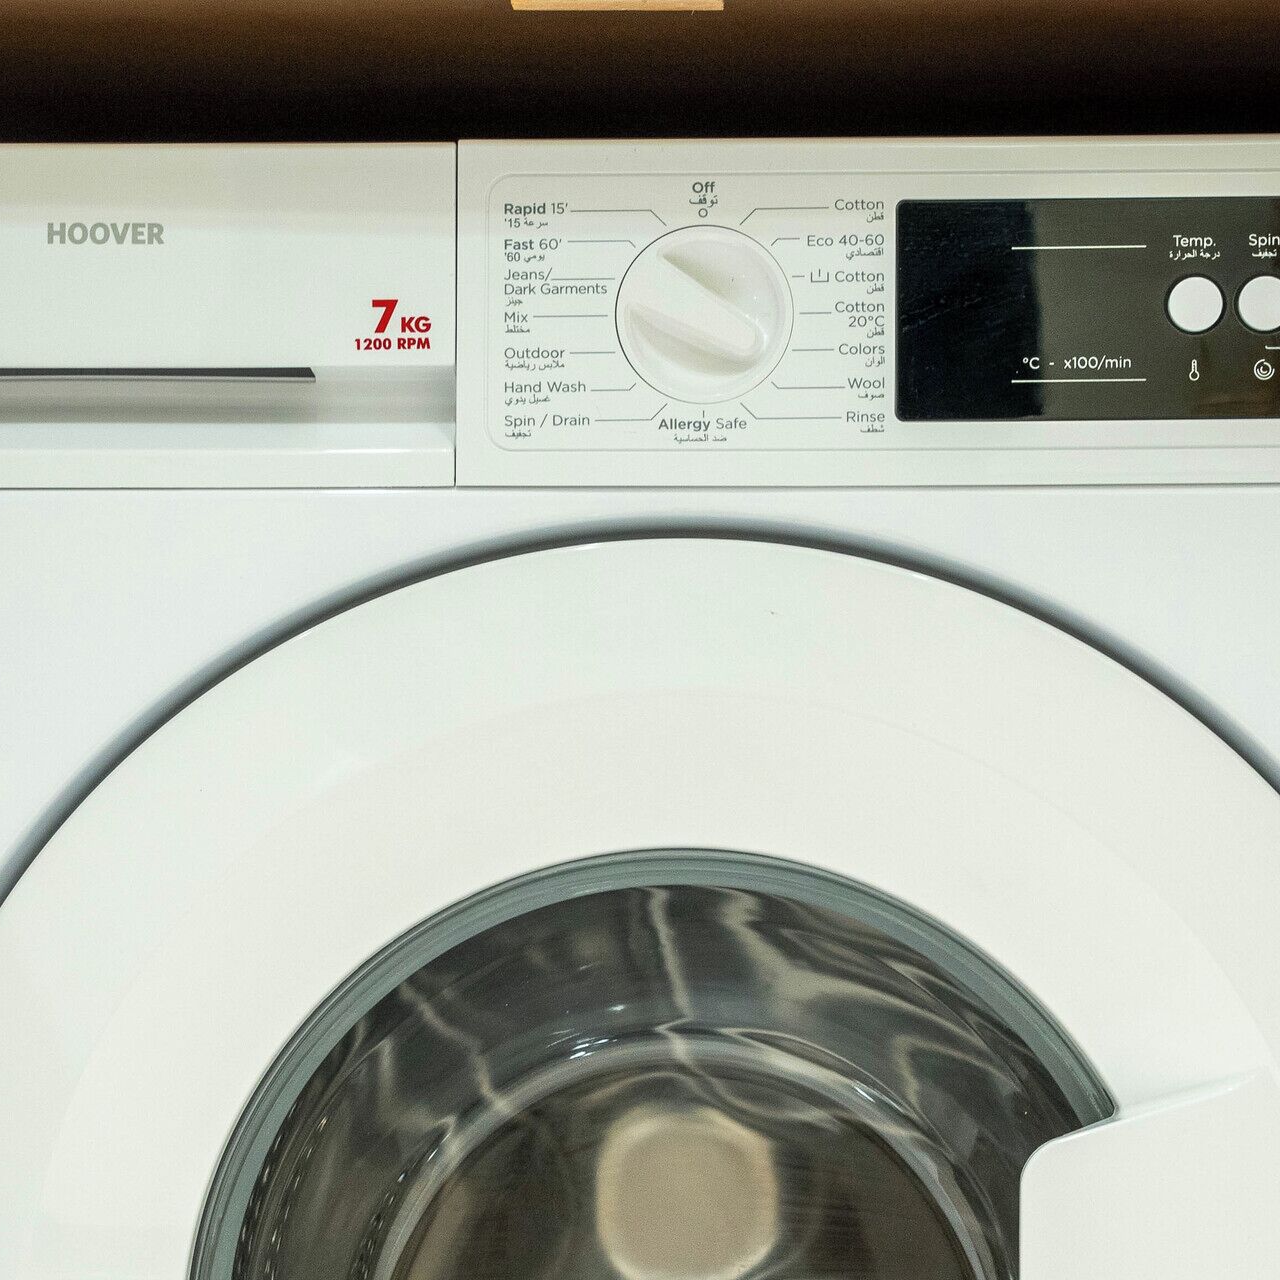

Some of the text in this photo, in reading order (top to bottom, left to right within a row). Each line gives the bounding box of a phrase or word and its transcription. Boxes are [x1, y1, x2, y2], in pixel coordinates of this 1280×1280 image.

[692, 181, 716, 194] Off
[688, 194, 718, 208] توقف
[834, 199, 885, 211] Cotton
[504, 203, 546, 216] Rapid
[866, 211, 885, 223] قطن
[47, 222, 164, 245] HOOVER
[504, 238, 535, 250] Fast
[807, 234, 885, 247] Eco 40-60
[1173, 234, 1216, 249] Temp.
[1248, 233, 1280, 248] Spin
[1200, 249, 1221, 260] درجة
[1251, 249, 1278, 259] تجفيف
[504, 267, 553, 282] Jeans/
[834, 270, 885, 283] Cotton
[504, 283, 608, 295] Dark Garments
[866, 283, 885, 294] قطن
[834, 301, 885, 313] Cotton
[371, 299, 432, 334] 7 KG
[504, 311, 529, 323] Mix
[848, 315, 885, 328] 20°C
[866, 327, 885, 339] قطن
[355, 337, 431, 351] 1200 RPM
[838, 343, 886, 356] Colors
[504, 347, 566, 359] Outdoor
[1063, 355, 1132, 371] x100/min
[504, 380, 587, 393] Hand Wash
[847, 377, 885, 389] Wool
[504, 415, 536, 428] Spin
[552, 414, 590, 426] Drain
[846, 411, 885, 422] Rinse
[658, 417, 747, 432] Allergy Safe
